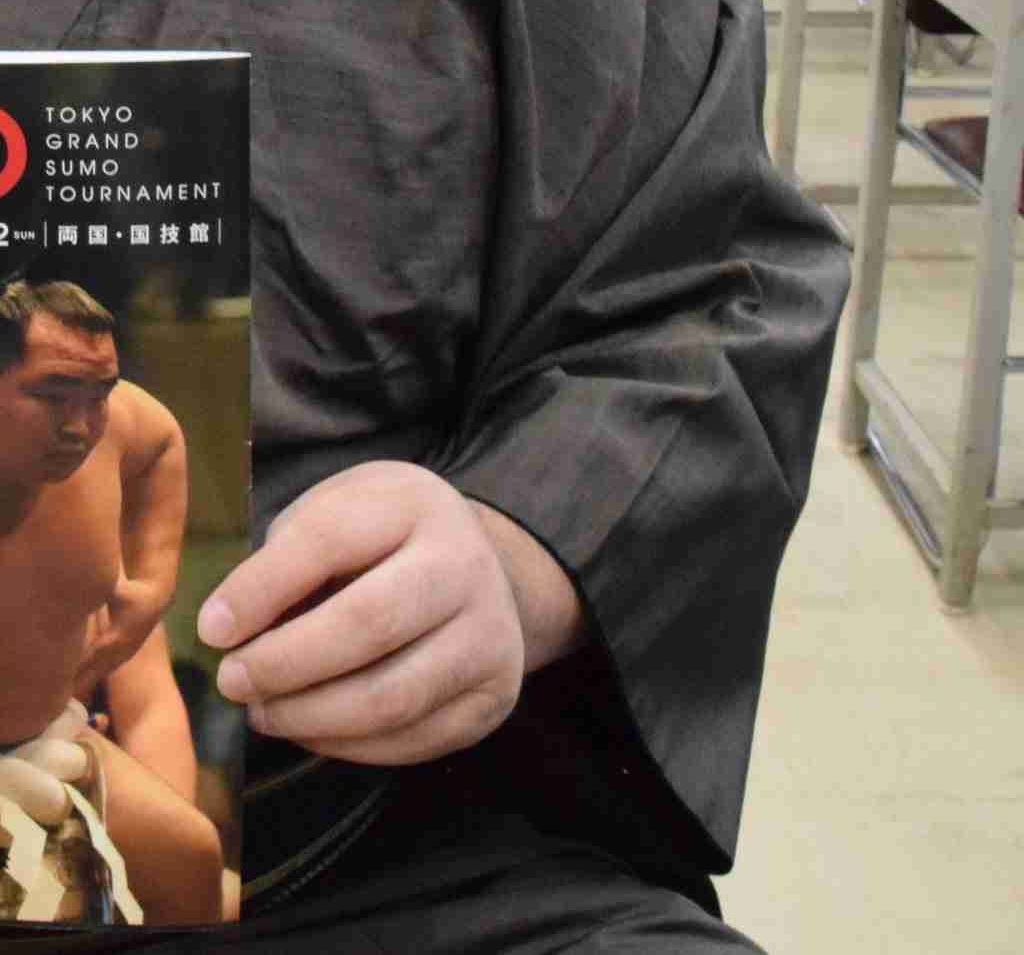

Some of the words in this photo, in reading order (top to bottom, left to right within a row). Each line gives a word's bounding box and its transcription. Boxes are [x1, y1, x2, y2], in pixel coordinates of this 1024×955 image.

[45, 106, 133, 124] TOKYO
[45, 132, 139, 150] GRAND
[45, 158, 120, 177] SUMO
[45, 182, 221, 203] TOURNAMENT
[13, 229, 36, 240] SUN
